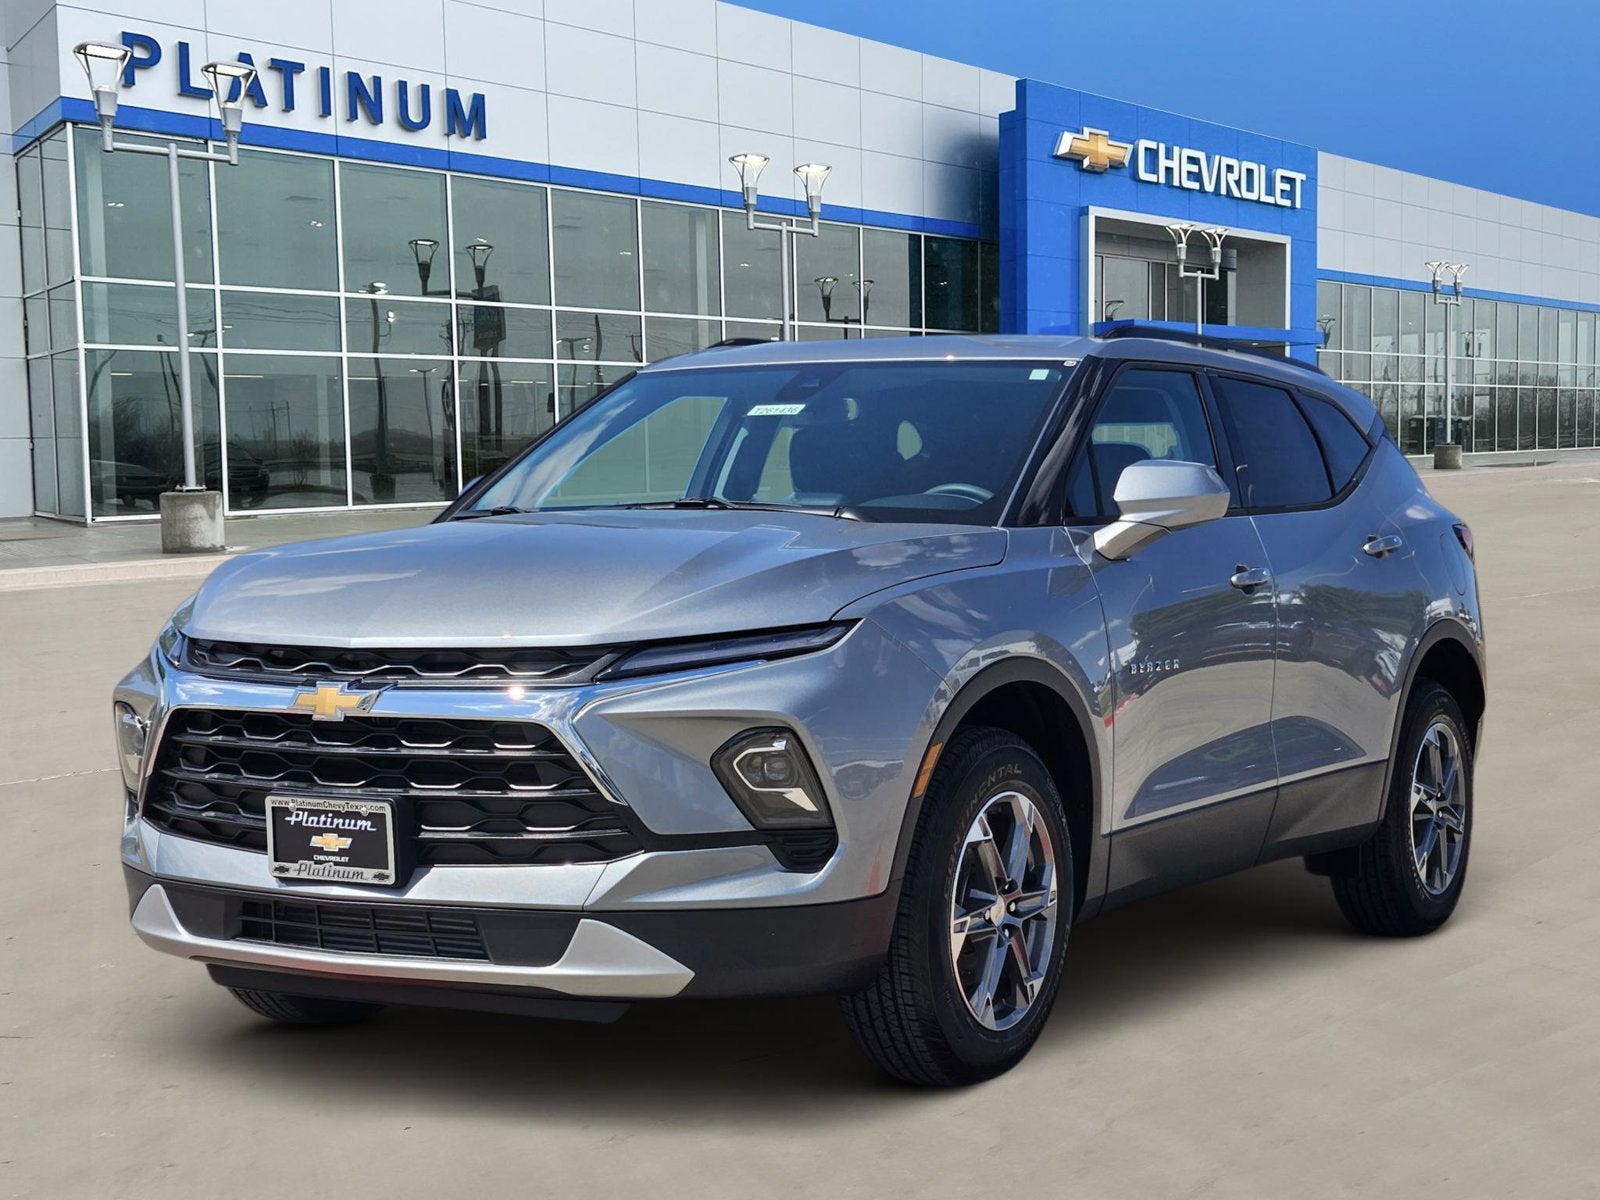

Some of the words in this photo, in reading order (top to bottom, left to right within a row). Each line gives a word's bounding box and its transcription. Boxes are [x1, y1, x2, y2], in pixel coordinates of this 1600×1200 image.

[121, 31, 487, 141] PLATINUM
[1137, 139, 1306, 208] CHEVROLET
[1130, 658, 1180, 675] BLAZER
[285, 810, 377, 831] Platinum
[313, 854, 349, 863] CHEVROLET
[293, 862, 369, 881] Platinum
